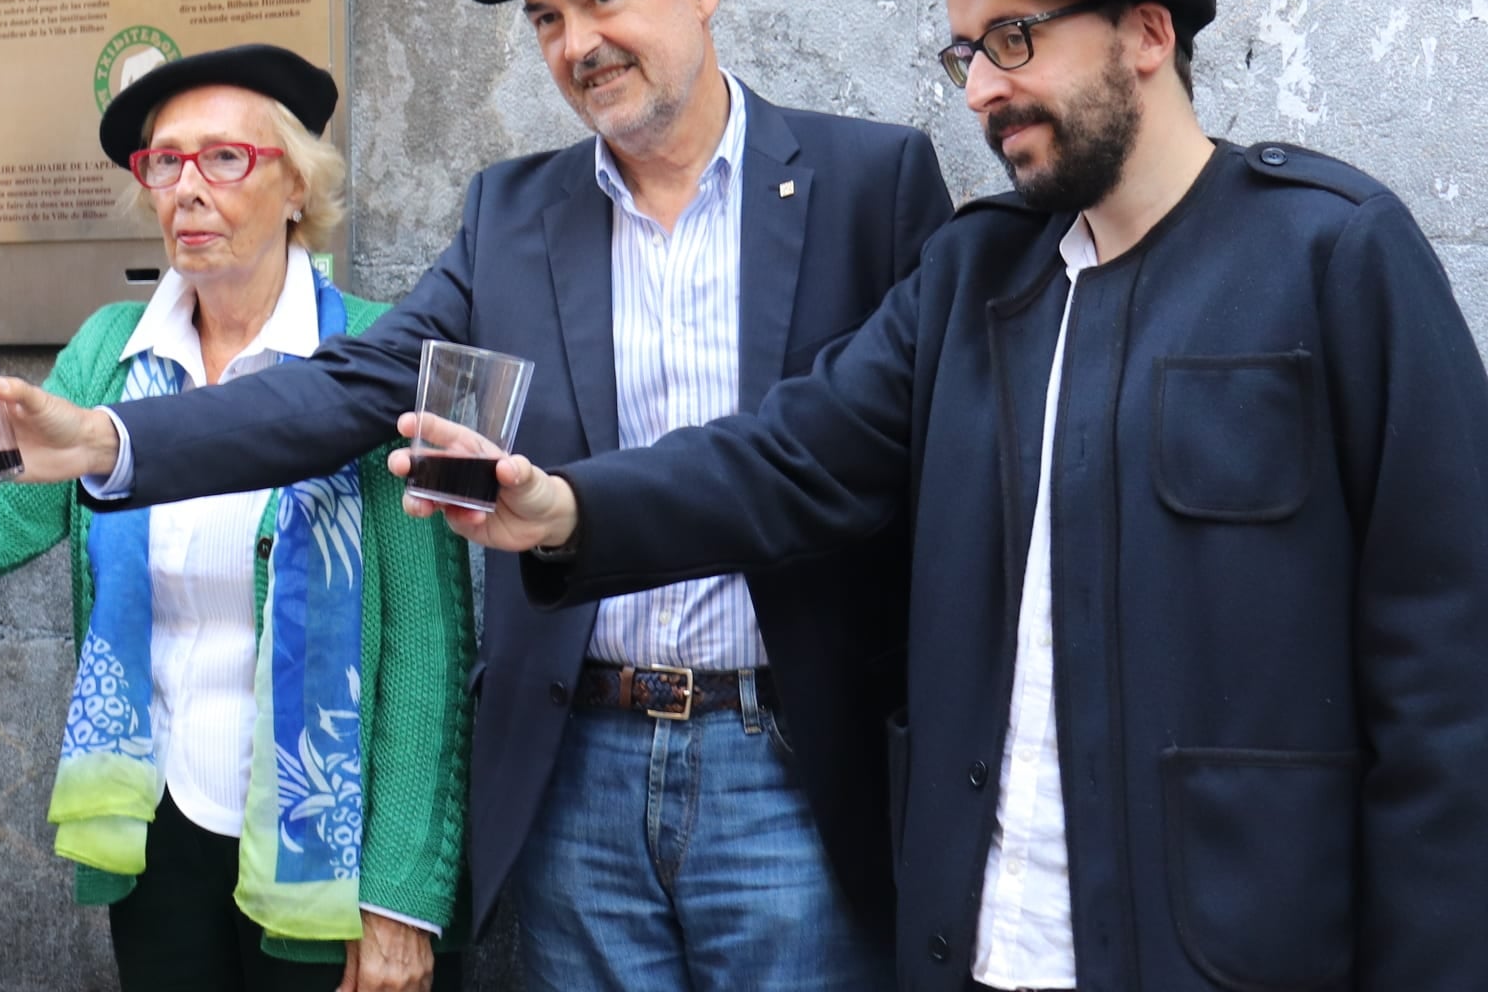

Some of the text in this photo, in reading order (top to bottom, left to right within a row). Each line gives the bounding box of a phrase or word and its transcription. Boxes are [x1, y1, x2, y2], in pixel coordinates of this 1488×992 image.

[60, 2, 69, 10] de
[71, 1, 81, 9] las
[189, 14, 228, 25] erakunde
[265, 8, 300, 19] emateko
[29, 29, 37, 37] de
[40, 28, 46, 36] la
[48, 27, 66, 35] Villa
[69, 26, 77, 34] de
[80, 25, 104, 33] Bilbao
[19, 162, 67, 174] SOLIDAIRE
[70, 162, 81, 170] DE
[85, 160, 117, 170] L'APER
[15, 177, 39, 185] mettre
[41, 176, 51, 184] les
[79, 175, 103, 184] jaunes
[64, 187, 76, 196] des
[7, 200, 23, 209] faire
[26, 200, 38, 209] des
[40, 199, 58, 208] dons
[60, 200, 74, 208] aux
[76, 198, 115, 207] institution
[31, 212, 40, 222] de
[42, 212, 50, 221] la
[52, 211, 68, 220] Ville
[71, 210, 79, 220] de
[82, 209, 107, 219] Bilbao
